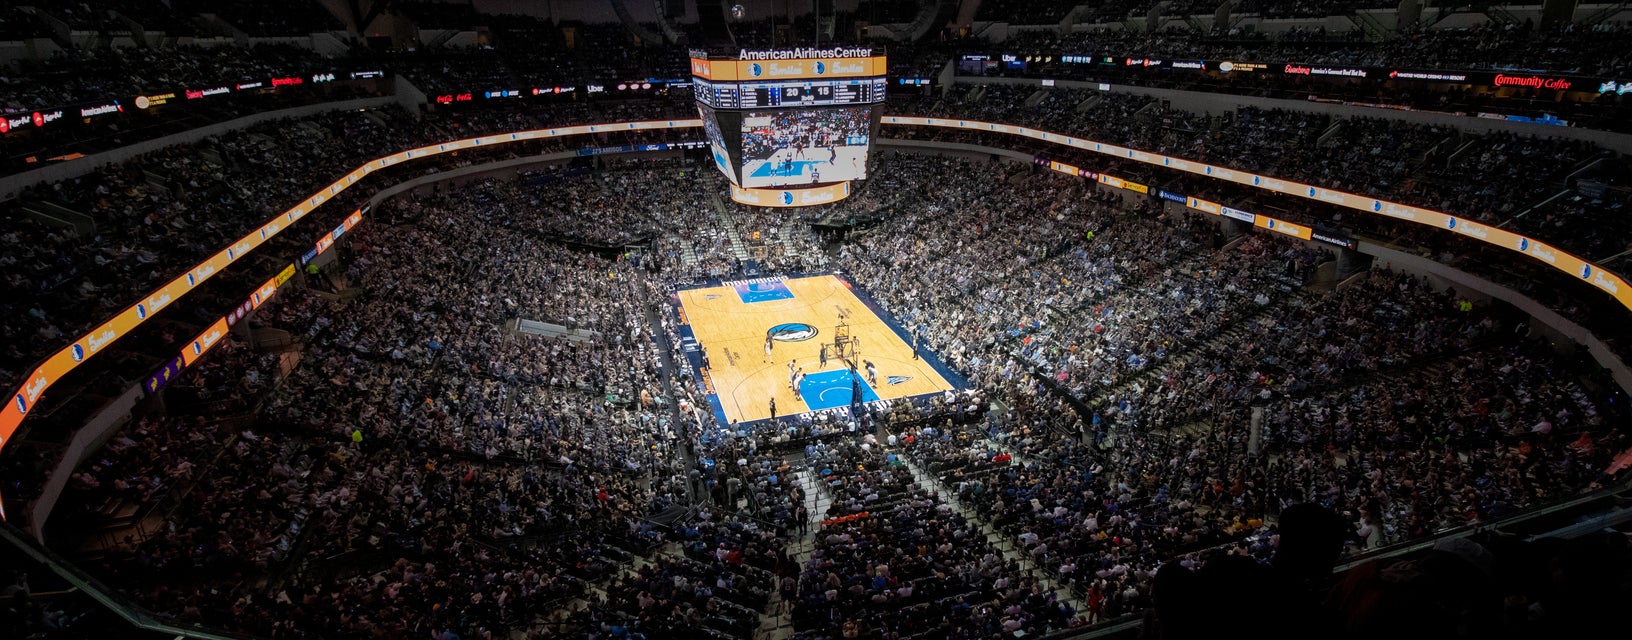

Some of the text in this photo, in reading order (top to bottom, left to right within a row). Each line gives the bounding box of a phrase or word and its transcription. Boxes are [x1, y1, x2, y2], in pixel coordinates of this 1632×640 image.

[1494, 73, 1572, 90] Community Coffee
[587, 85, 604, 93] Uber
[786, 88, 798, 96] 20
[818, 87, 829, 95] 15
